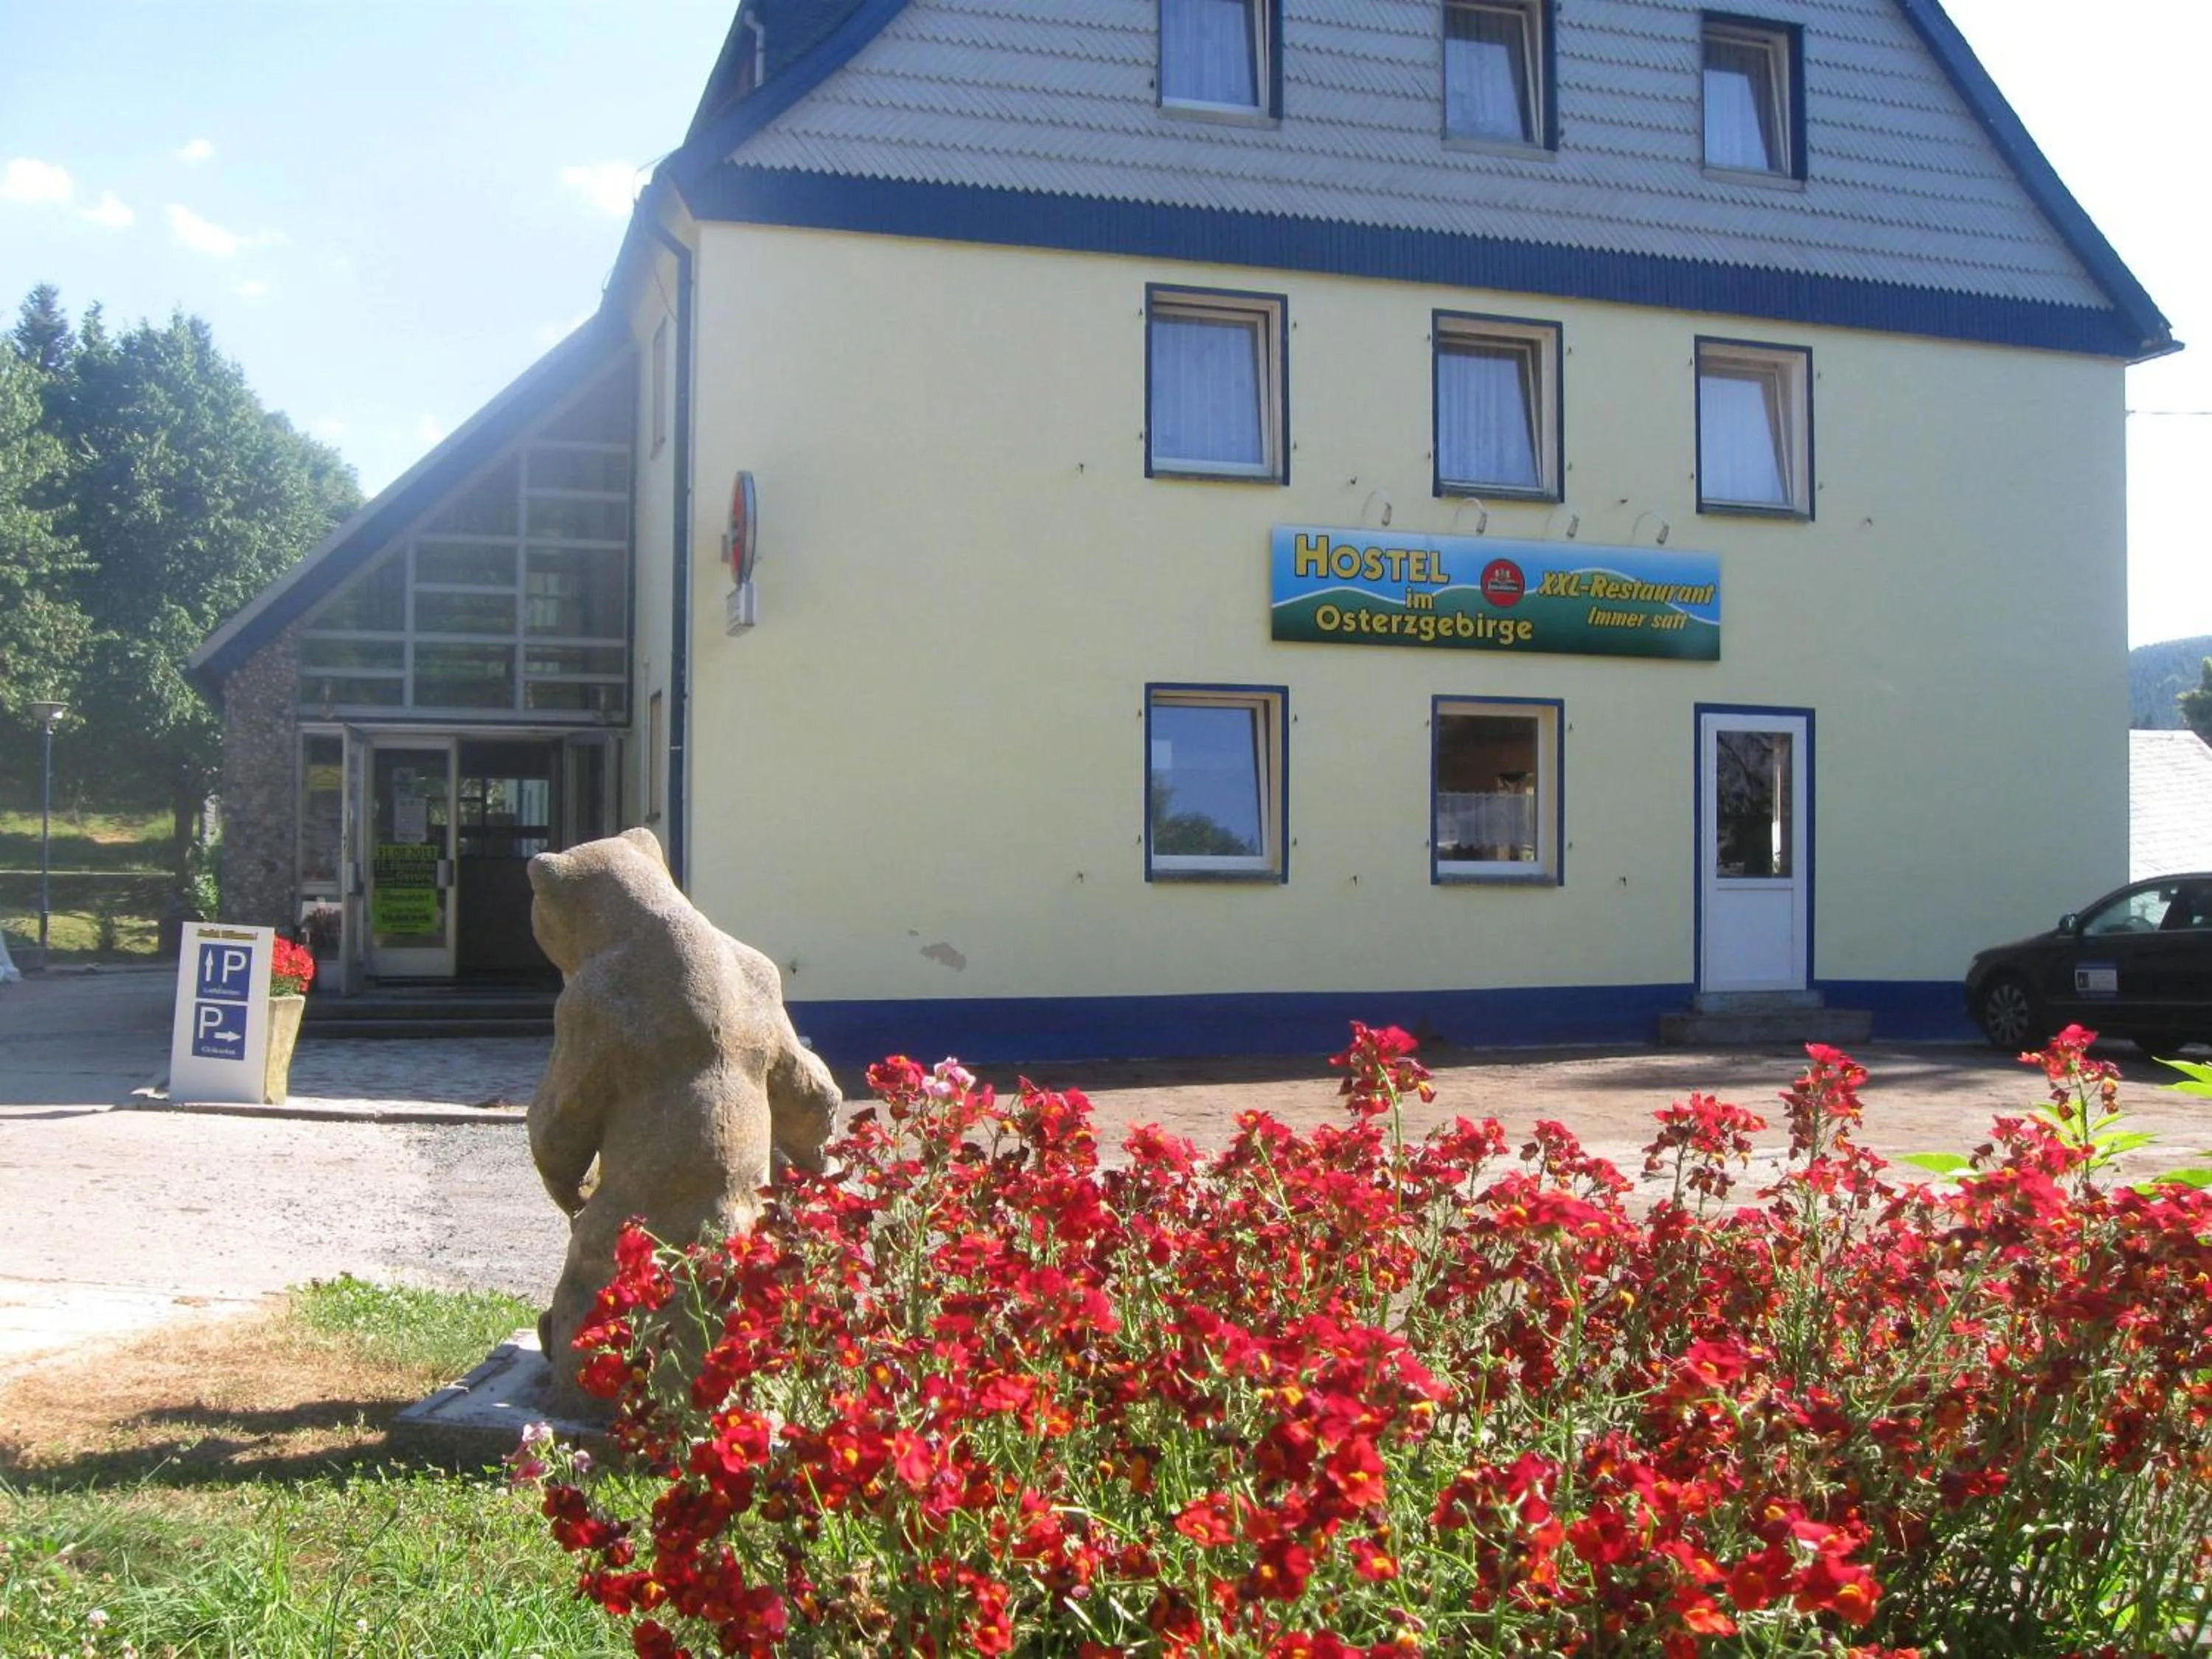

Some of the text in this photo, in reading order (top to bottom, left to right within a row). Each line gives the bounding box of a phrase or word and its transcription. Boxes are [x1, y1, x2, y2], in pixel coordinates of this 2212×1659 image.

[1405, 587, 1434, 610] im
[1537, 570, 1717, 605] XXL-Restaurant
[1315, 604, 1534, 646] Osterzgebirge
[1587, 606, 1688, 630] Immer satt
[222, 950, 247, 984] P
[198, 1006, 223, 1039] P
